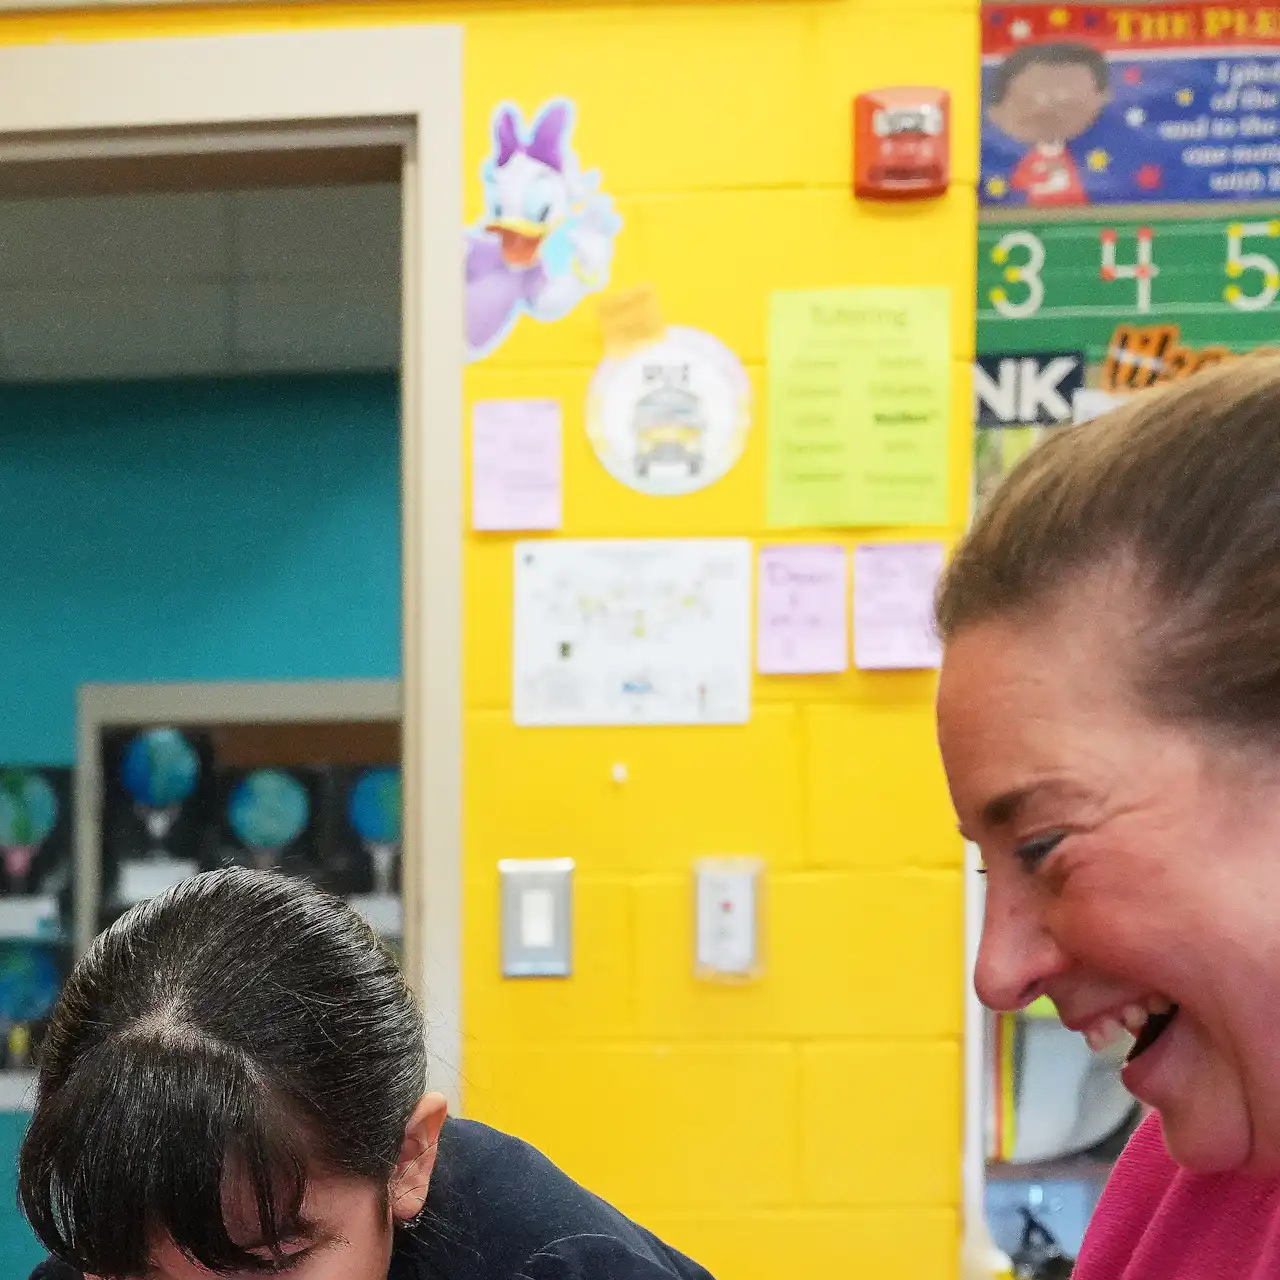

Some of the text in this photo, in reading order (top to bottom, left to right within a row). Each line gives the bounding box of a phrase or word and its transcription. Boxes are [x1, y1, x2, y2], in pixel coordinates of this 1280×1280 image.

[1111, 9, 1195, 41] THE
[1239, 86, 1279, 109] the
[1159, 114, 1209, 140] and
[1239, 114, 1279, 137] the
[1182, 146, 1230, 166] one
[989, 220, 1280, 318] 3 4 5
